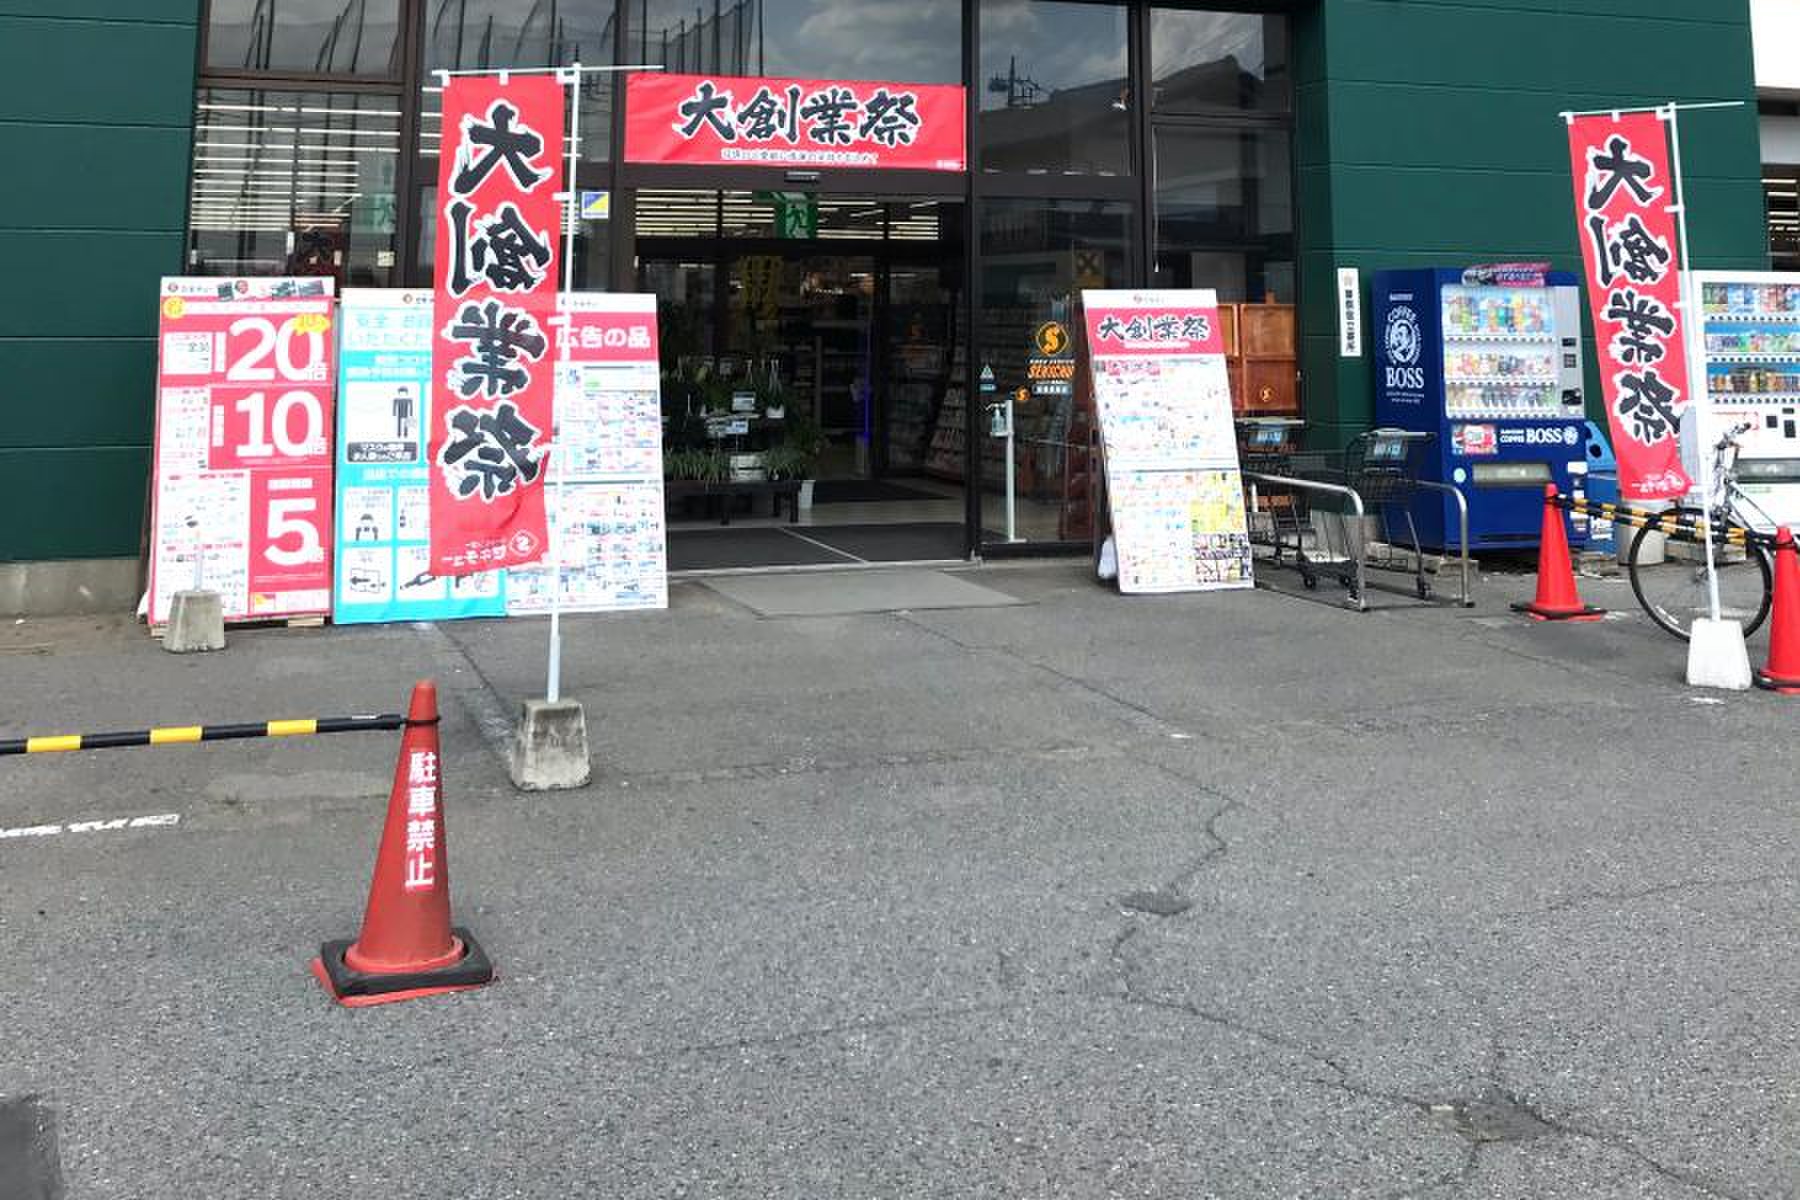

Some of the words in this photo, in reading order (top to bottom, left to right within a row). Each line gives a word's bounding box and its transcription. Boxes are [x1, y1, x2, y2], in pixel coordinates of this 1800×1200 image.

[674, 81, 922, 147] 大創業祭
[226, 317, 326, 381] 20
[1097, 314, 1210, 341] 大創業祭
[1386, 366, 1425, 389] BOSS
[235, 390, 325, 458] 10
[1526, 428, 1562, 444] BOSS
[264, 499, 320, 566] 5
[405, 751, 437, 887] 駐車禁止
